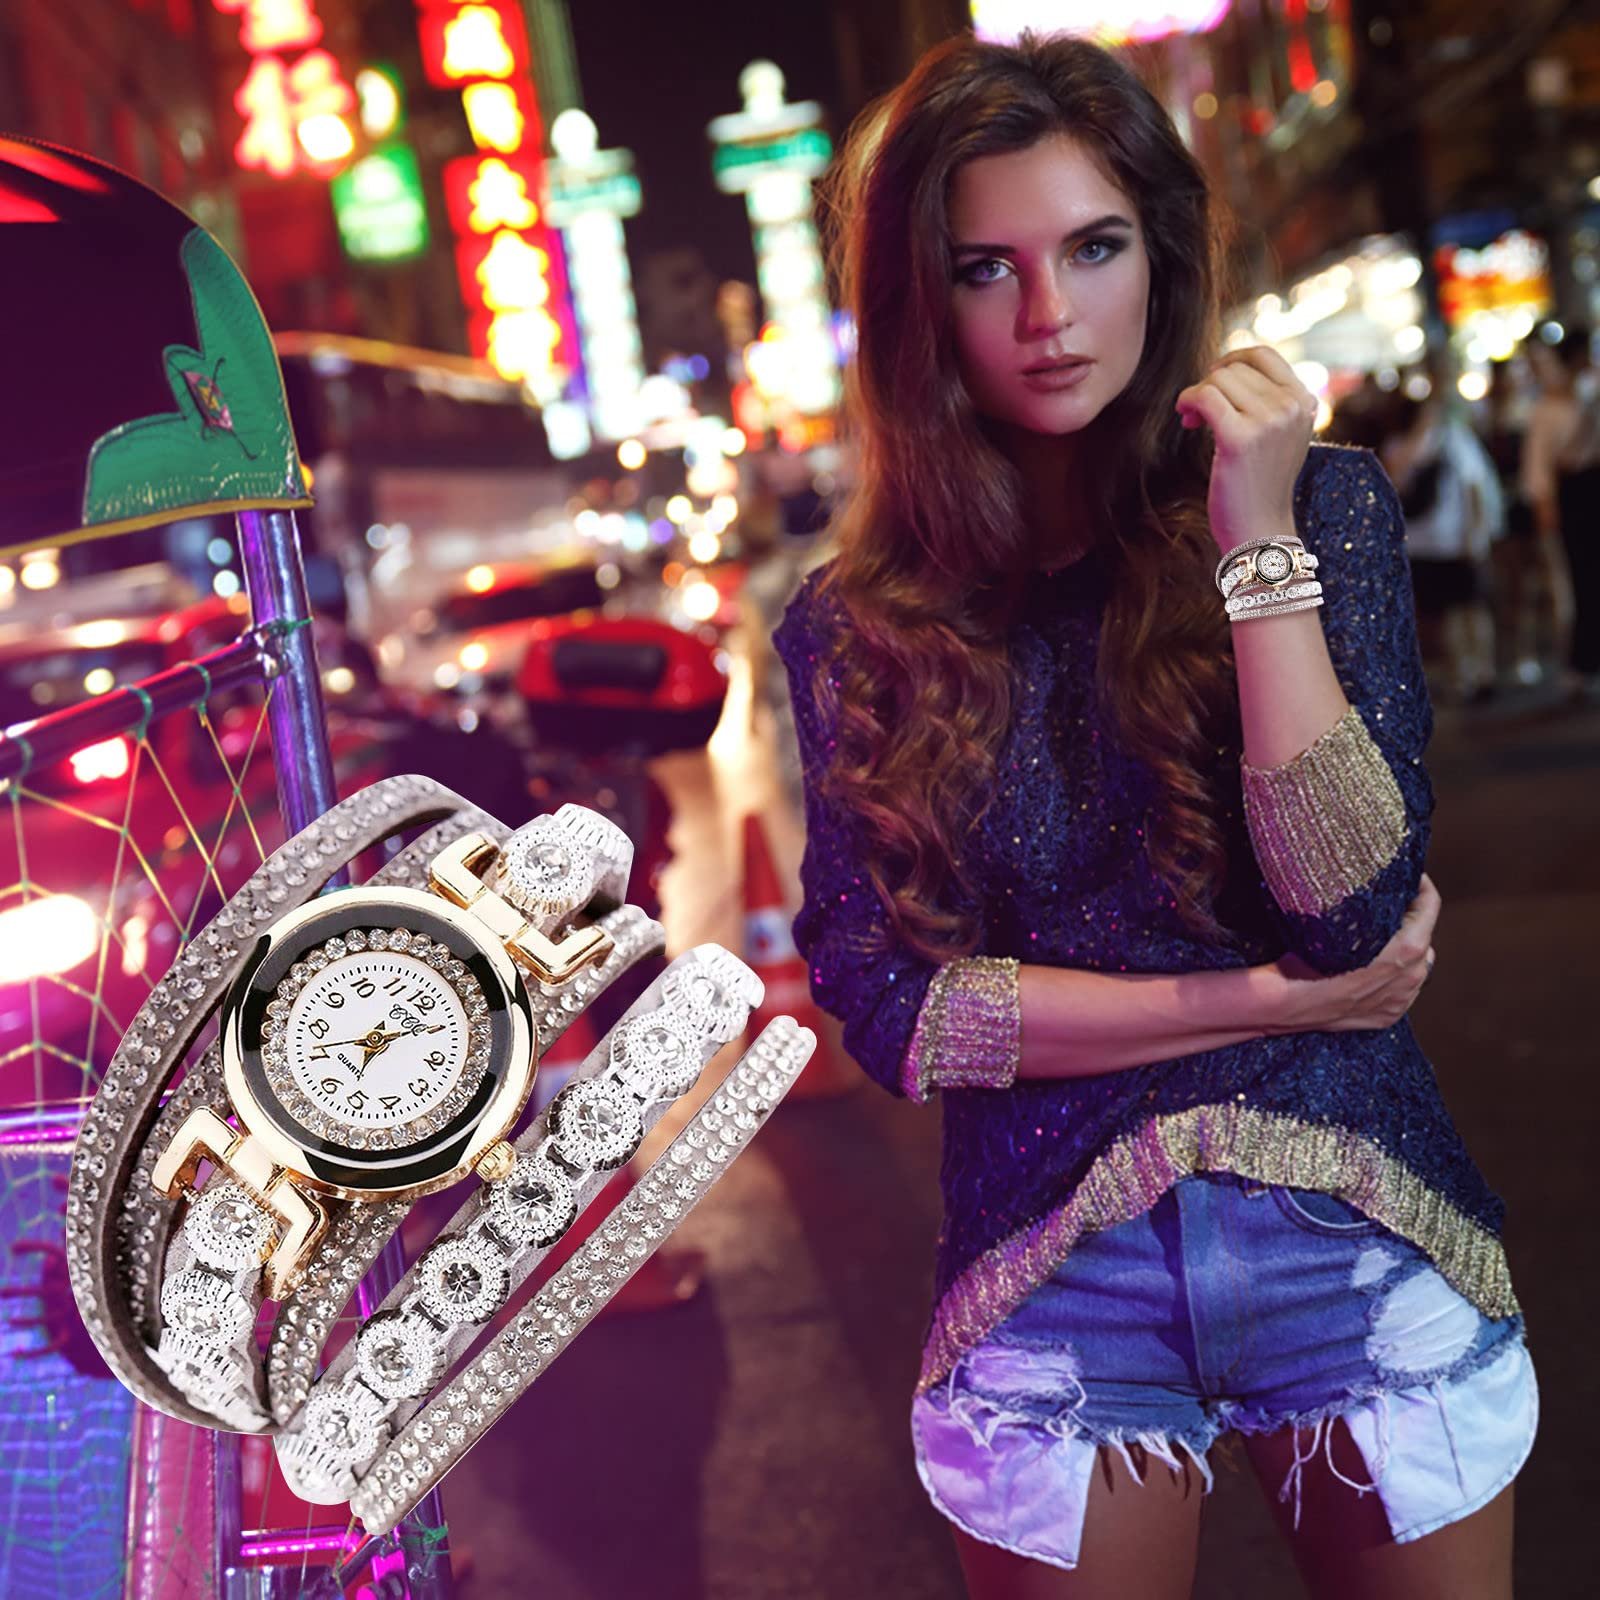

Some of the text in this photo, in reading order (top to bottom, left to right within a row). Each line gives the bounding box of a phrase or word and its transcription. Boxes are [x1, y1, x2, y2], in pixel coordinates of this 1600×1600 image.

[351, 977, 376, 998] 10
[383, 976, 407, 997] 11
[322, 992, 345, 1009] 9
[407, 989, 436, 1016] 12
[308, 1018, 330, 1039] 8
[423, 1050, 445, 1071] 2
[320, 1077, 344, 1095] 6
[408, 1078, 429, 1097] 3
[346, 1090, 369, 1110] 5
[378, 1095, 402, 1110] 4
